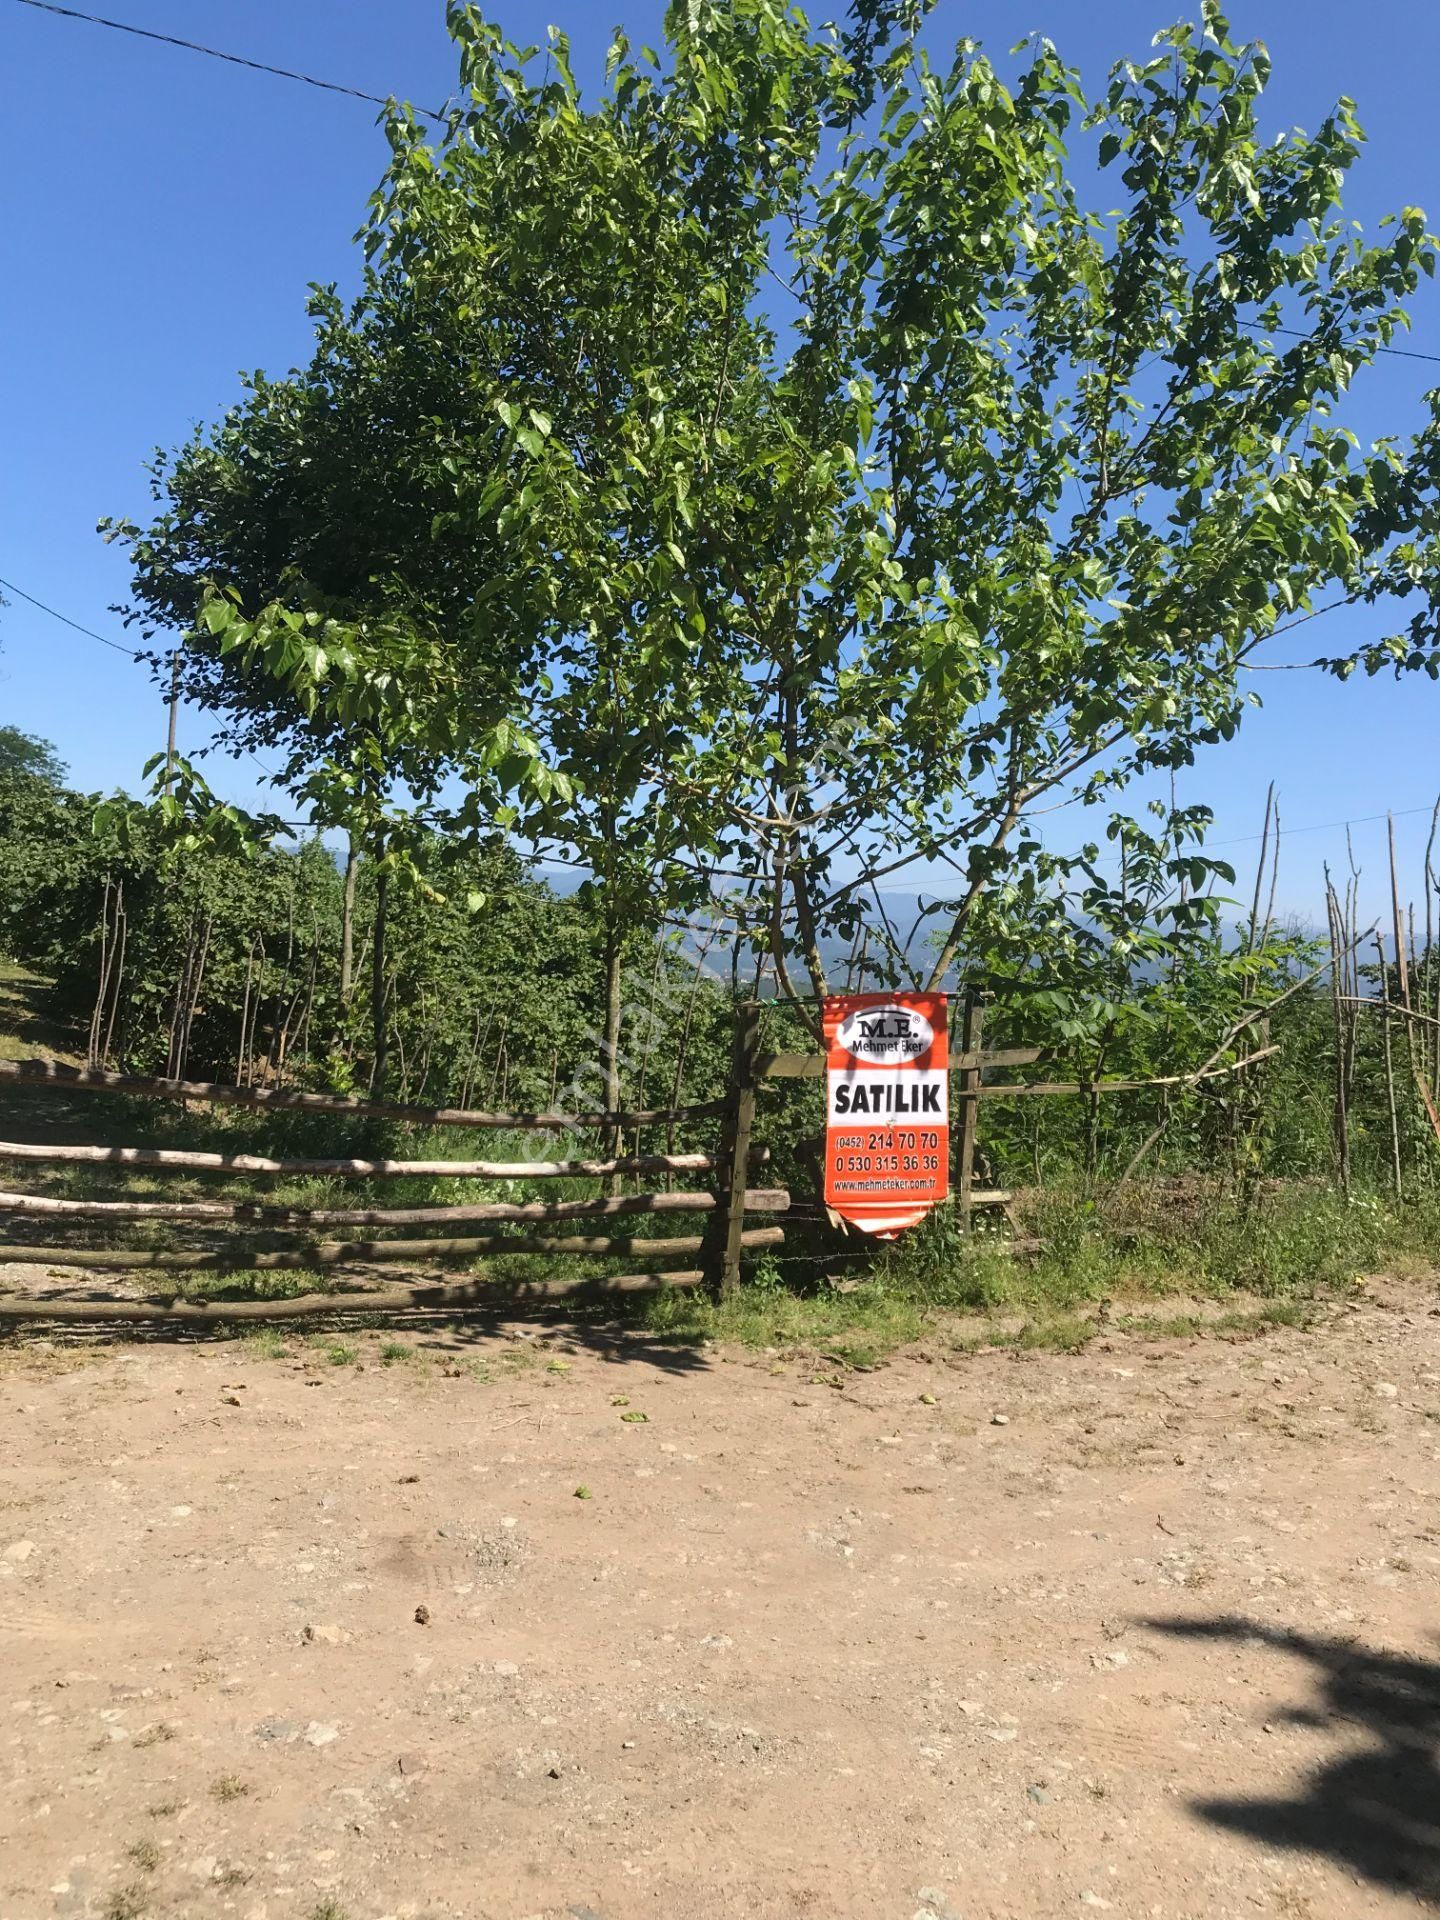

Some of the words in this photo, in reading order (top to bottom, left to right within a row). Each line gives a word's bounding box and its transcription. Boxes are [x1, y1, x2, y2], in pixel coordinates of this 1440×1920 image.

[857, 1019, 919, 1038] M.E.
[852, 1040, 899, 1053] Mehmet
[901, 1040, 923, 1053] Eker
[834, 1084, 942, 1114] SATILIK
[835, 1136, 865, 1150] (0452)
[868, 1133, 894, 1150] 214
[898, 1133, 916, 1149] 70
[920, 1133, 939, 1149] 70
[836, 1157, 844, 1172] 0
[847, 1157, 872, 1172] 530
[875, 1156, 899, 1171] 315
[903, 1156, 919, 1171] 36
[923, 1155, 939, 1170] 36
[834, 1178, 936, 1192] www.mehmeteker.com.tr
